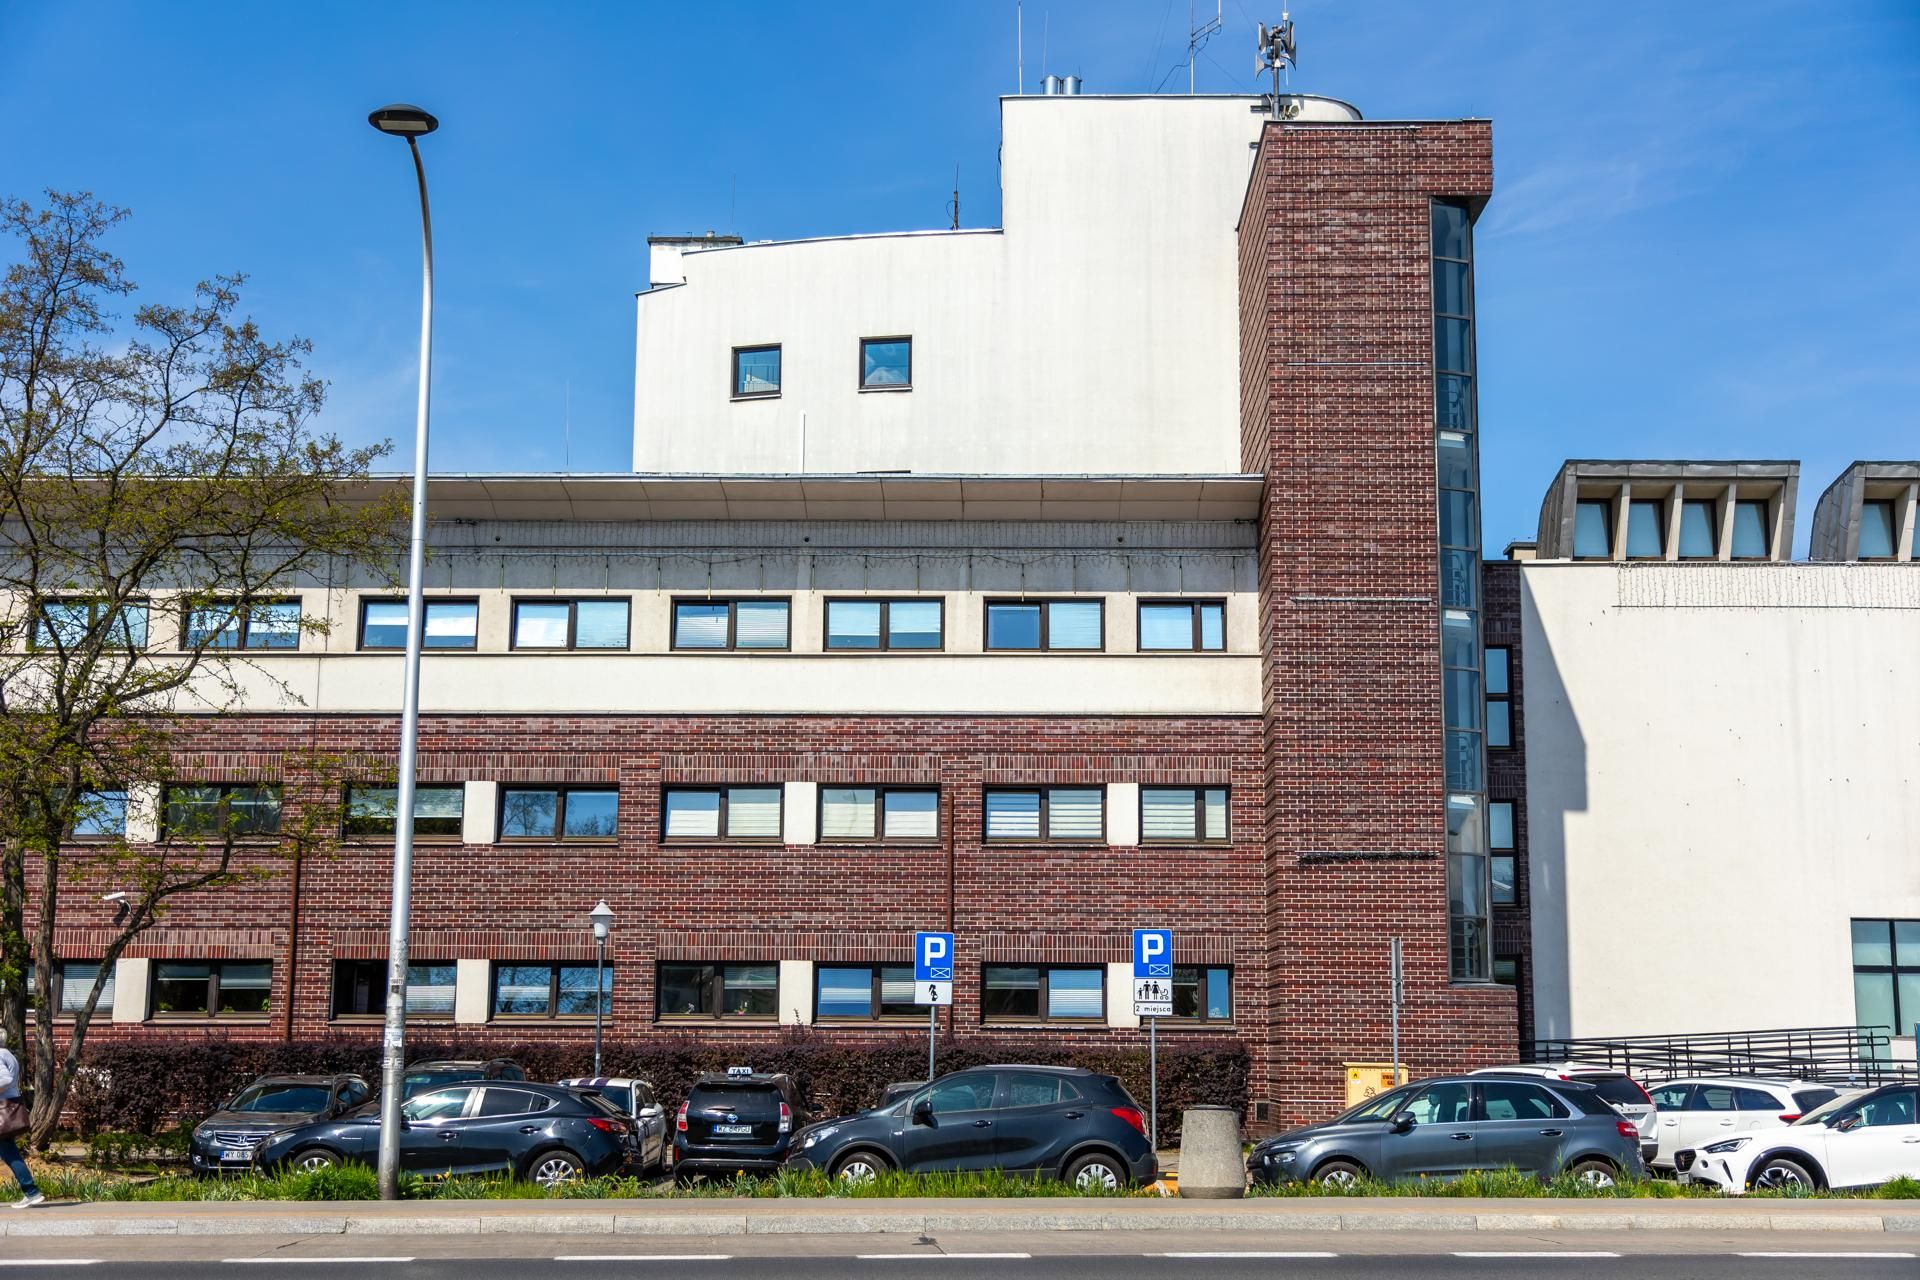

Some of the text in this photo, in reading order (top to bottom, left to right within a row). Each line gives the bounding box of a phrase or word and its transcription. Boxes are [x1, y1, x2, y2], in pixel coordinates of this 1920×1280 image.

[924, 937, 946, 966] P
[1142, 934, 1164, 963] P
[1144, 1005, 1171, 1013] miejsca
